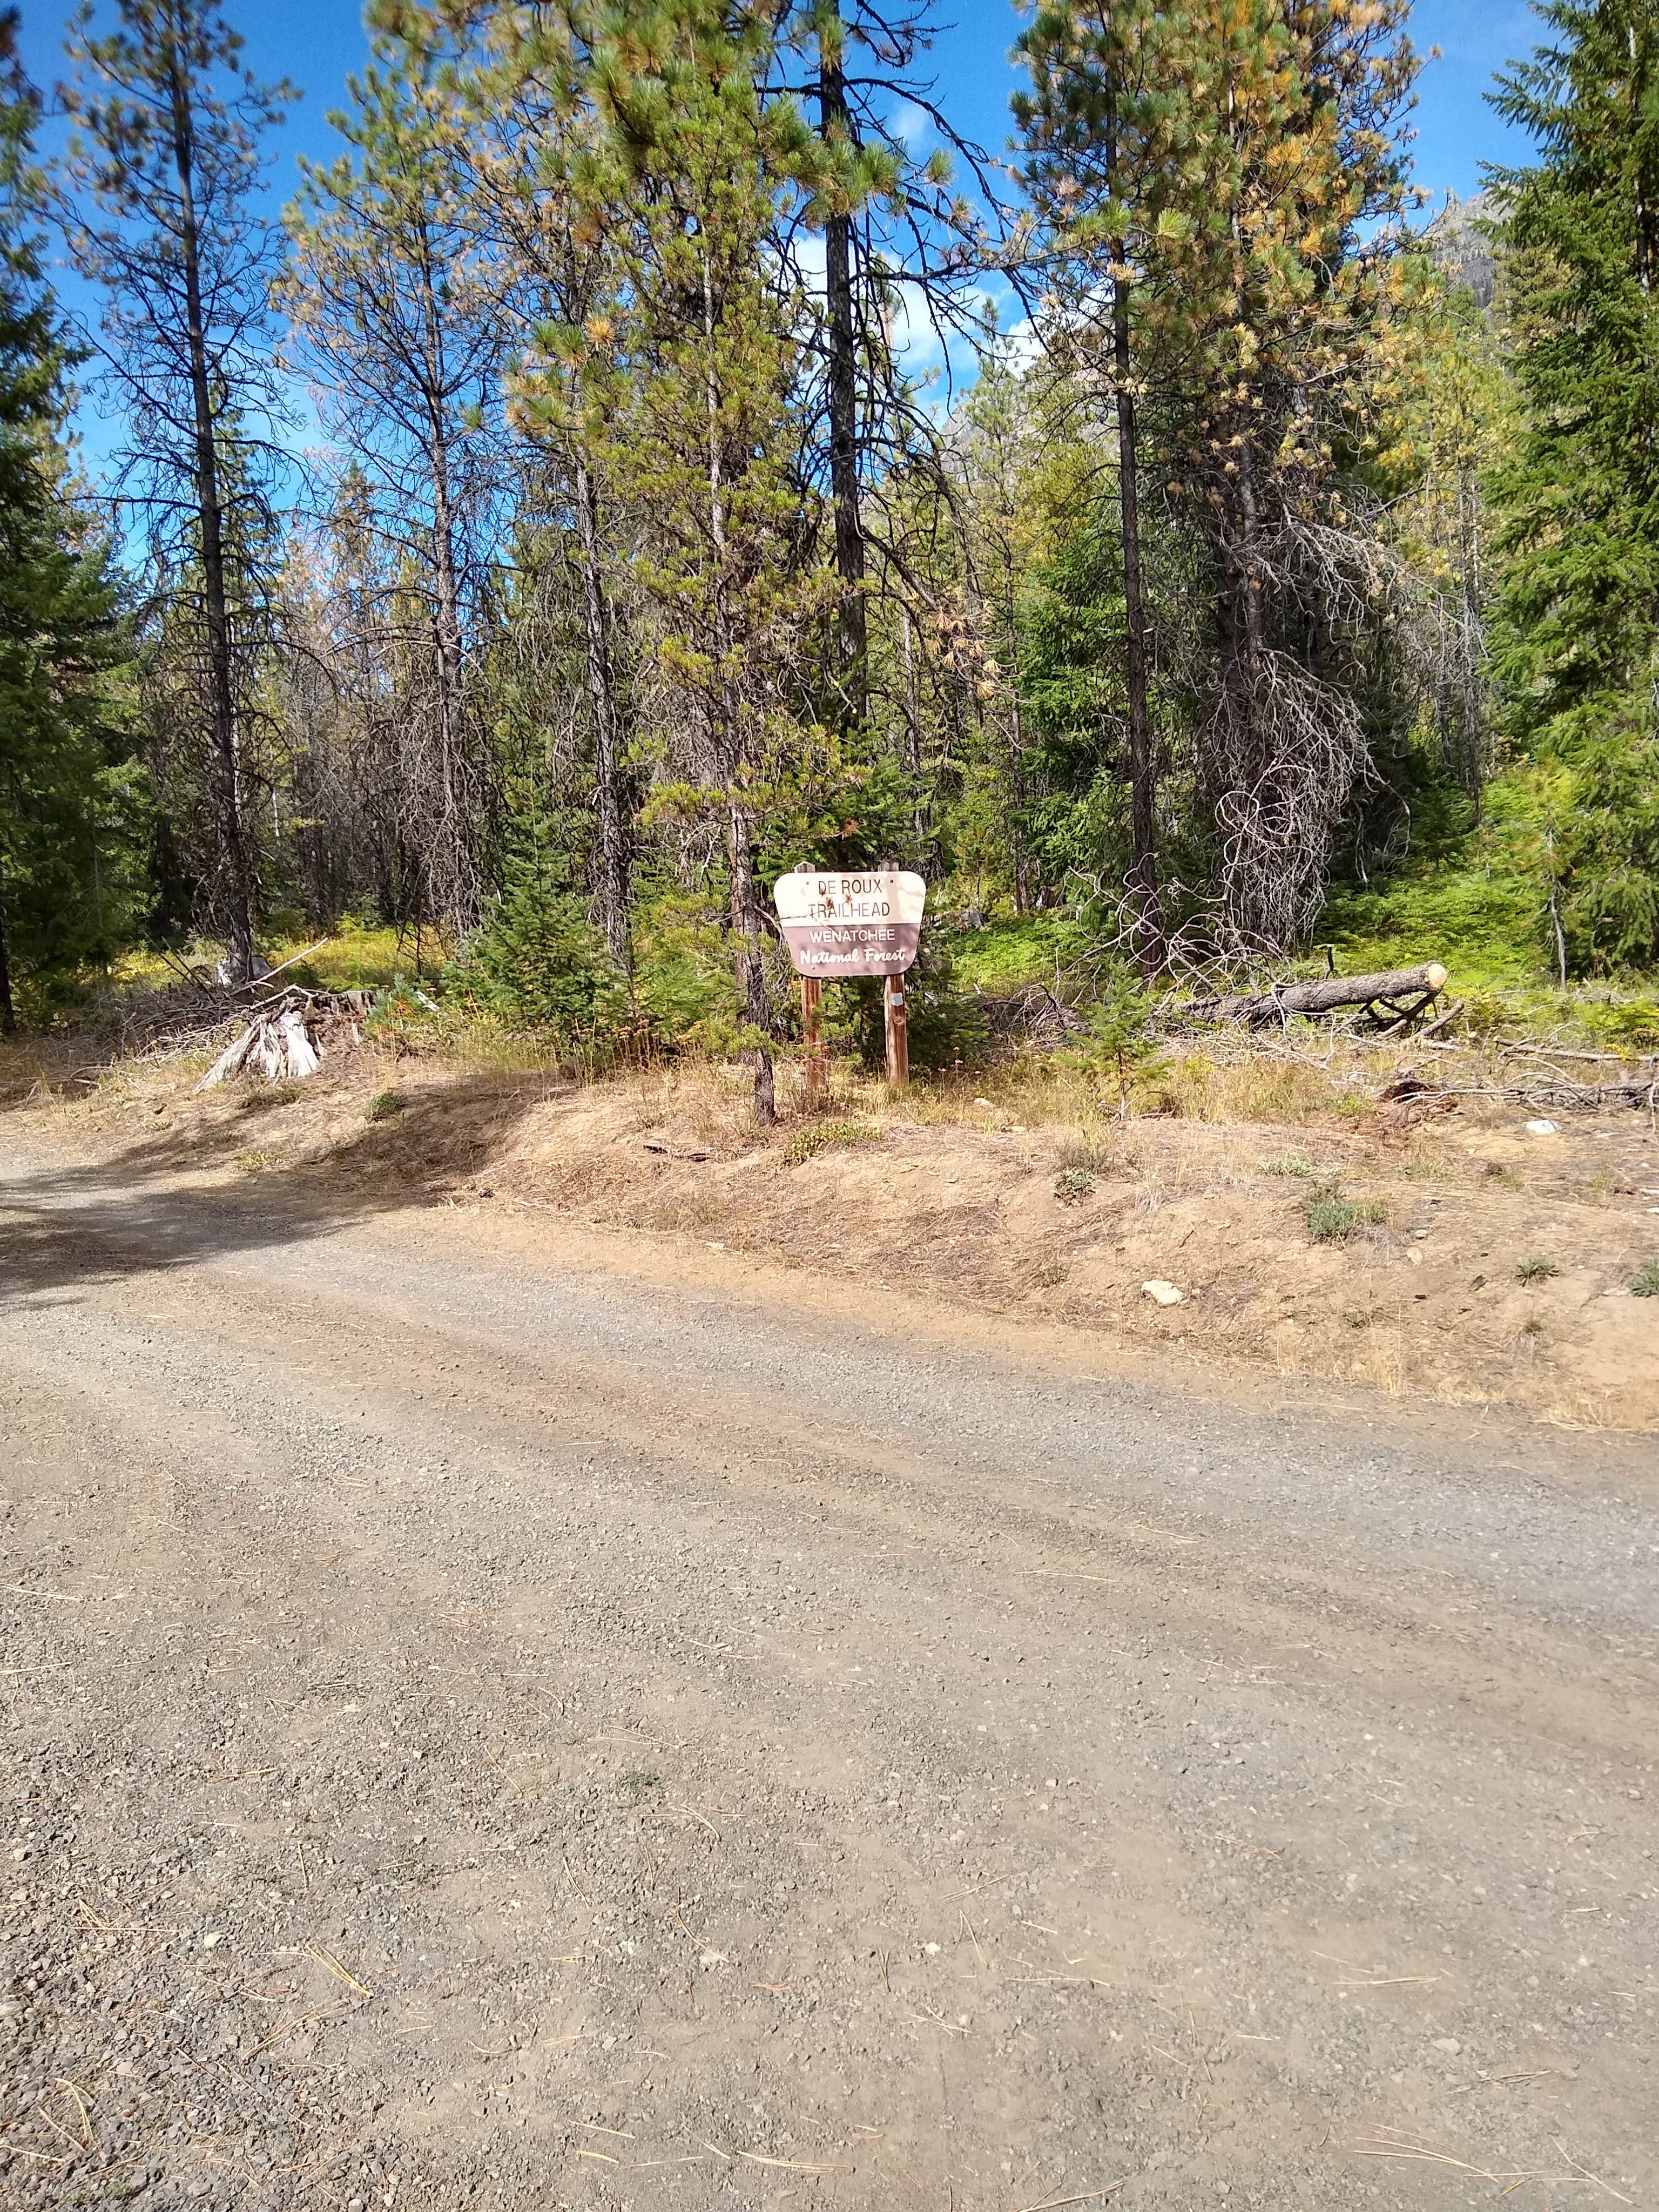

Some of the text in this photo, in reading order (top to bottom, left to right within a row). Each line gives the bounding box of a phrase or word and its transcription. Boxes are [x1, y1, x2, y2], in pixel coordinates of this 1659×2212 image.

[819, 879, 882, 895] DE ROUX
[808, 902, 890, 918] TRAILHEAD
[810, 928, 896, 943] WENATCHEE
[800, 947, 906, 965] National Forest
